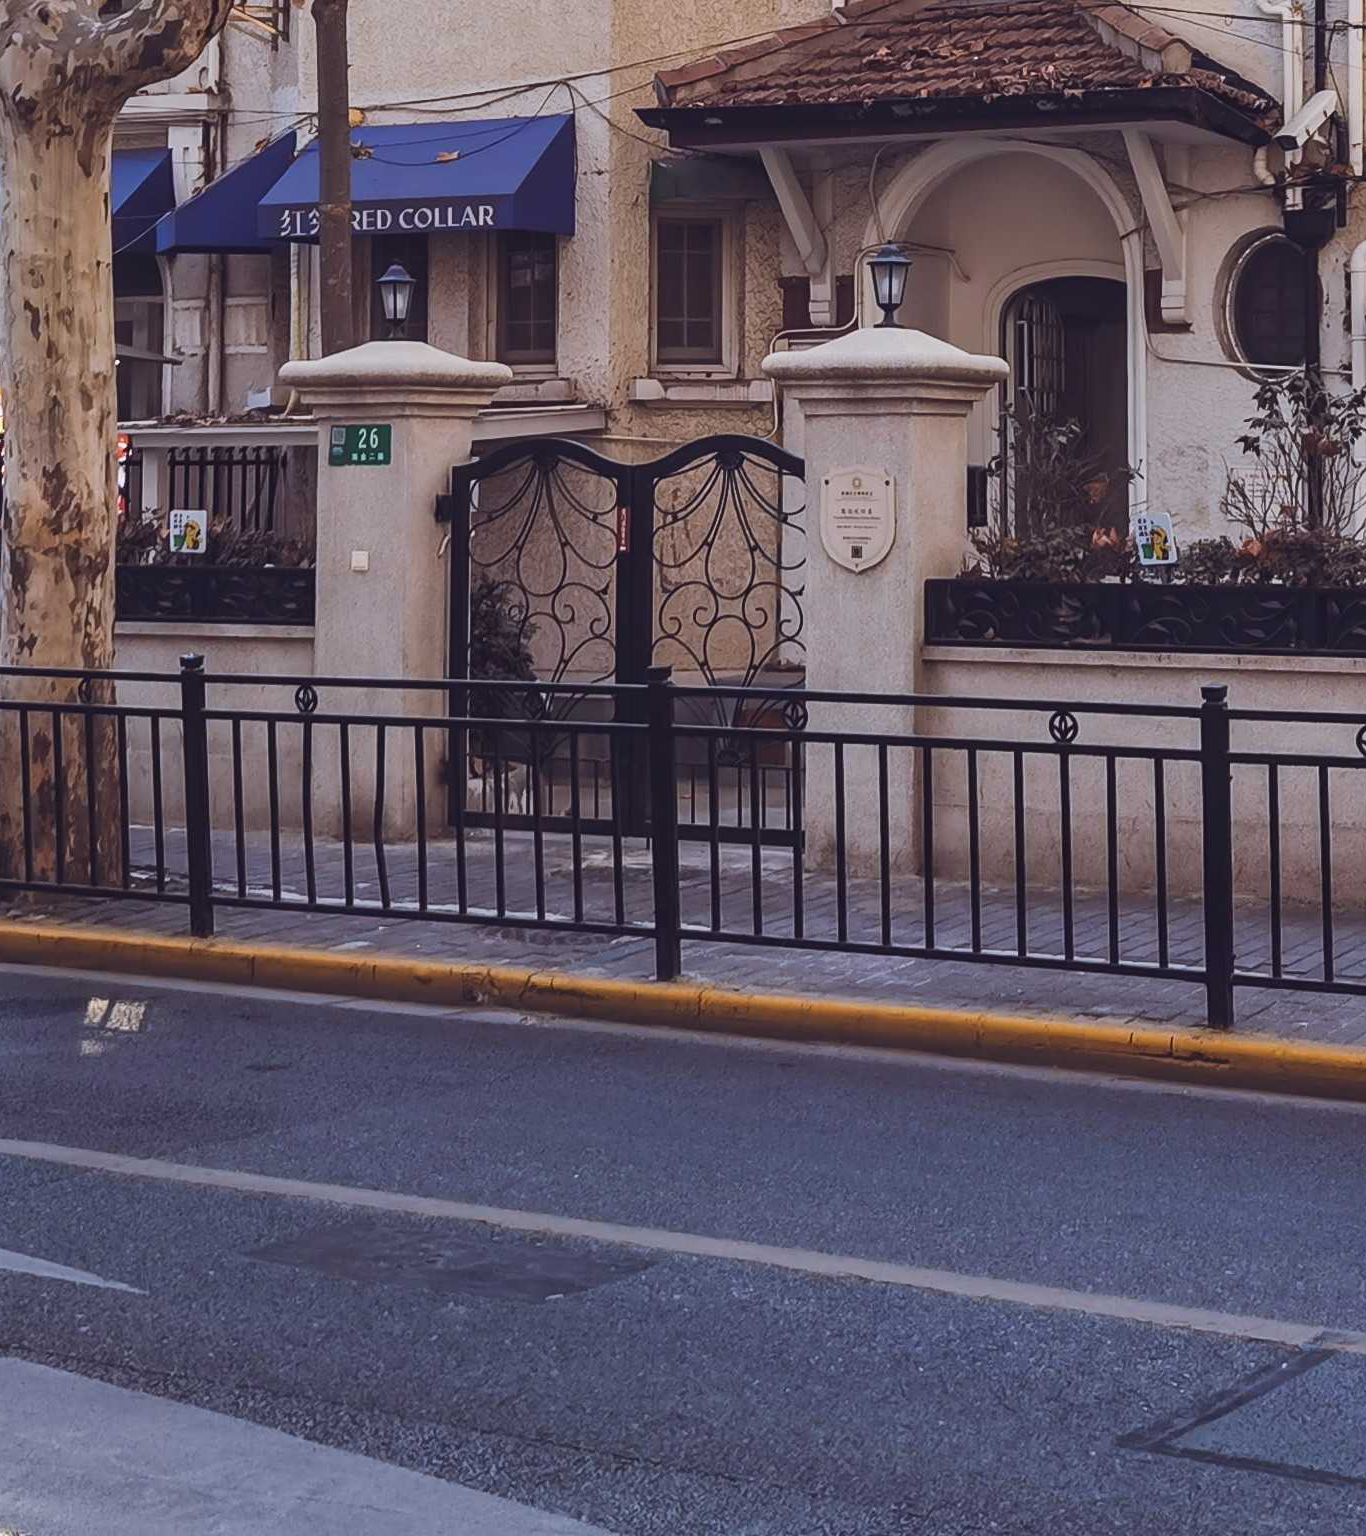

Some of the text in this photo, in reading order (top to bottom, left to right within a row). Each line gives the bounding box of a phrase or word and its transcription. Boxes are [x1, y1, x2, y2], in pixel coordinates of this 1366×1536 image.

[280, 205, 494, 236] 红 RED COLLAR
[358, 428, 378, 449] 26
